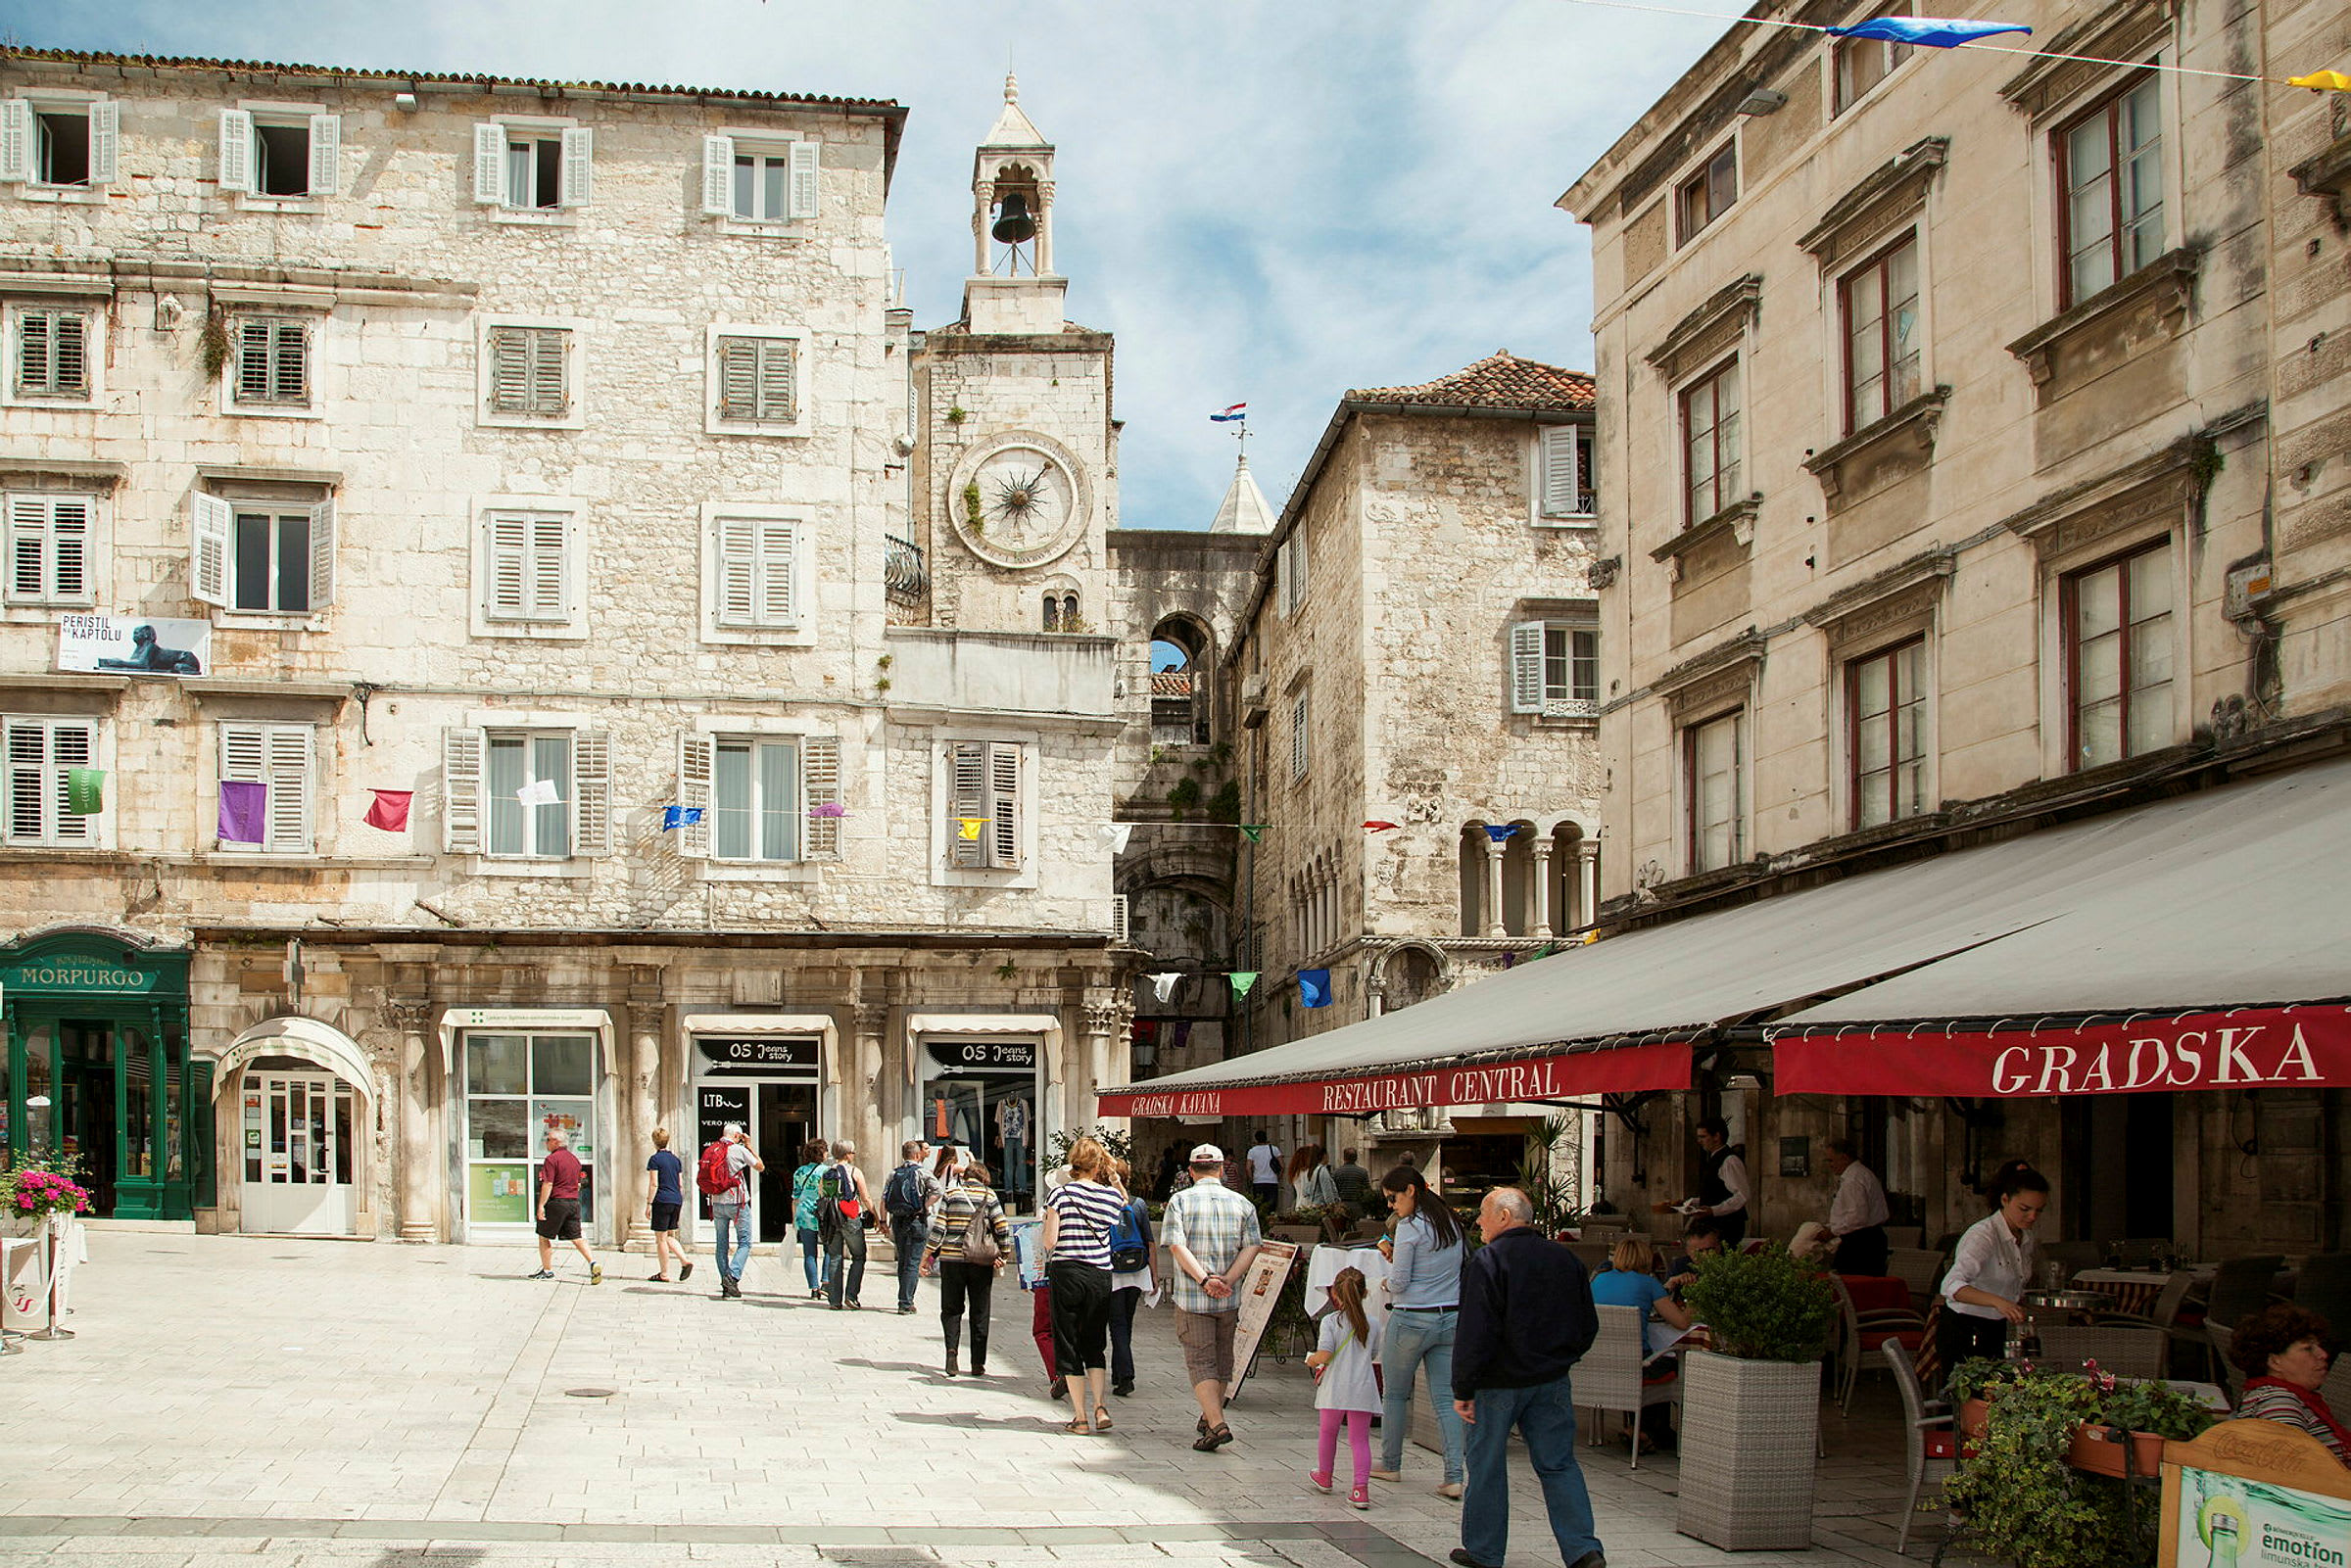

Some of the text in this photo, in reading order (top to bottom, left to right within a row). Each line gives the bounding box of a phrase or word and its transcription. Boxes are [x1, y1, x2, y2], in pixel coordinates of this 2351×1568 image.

[63, 615, 111, 629] PERISTIL
[72, 628, 122, 641] KAPTOLU
[21, 968, 144, 986] MORPURGO
[730, 1043, 789, 1059] OS Jeans
[768, 1053, 792, 1063] story
[962, 1045, 1028, 1062] OS Jeans
[1005, 1054, 1032, 1065] story
[1991, 1022, 2326, 1094] GRADSKA
[1322, 1062, 1560, 1112] RESTAURANT CENTRAL
[703, 1094, 723, 1108] LTB
[1131, 1092, 1222, 1116] GRADSKA KAVANA
[2260, 1547, 2310, 1568] limunska
[2262, 1534, 2343, 1566] emotion
